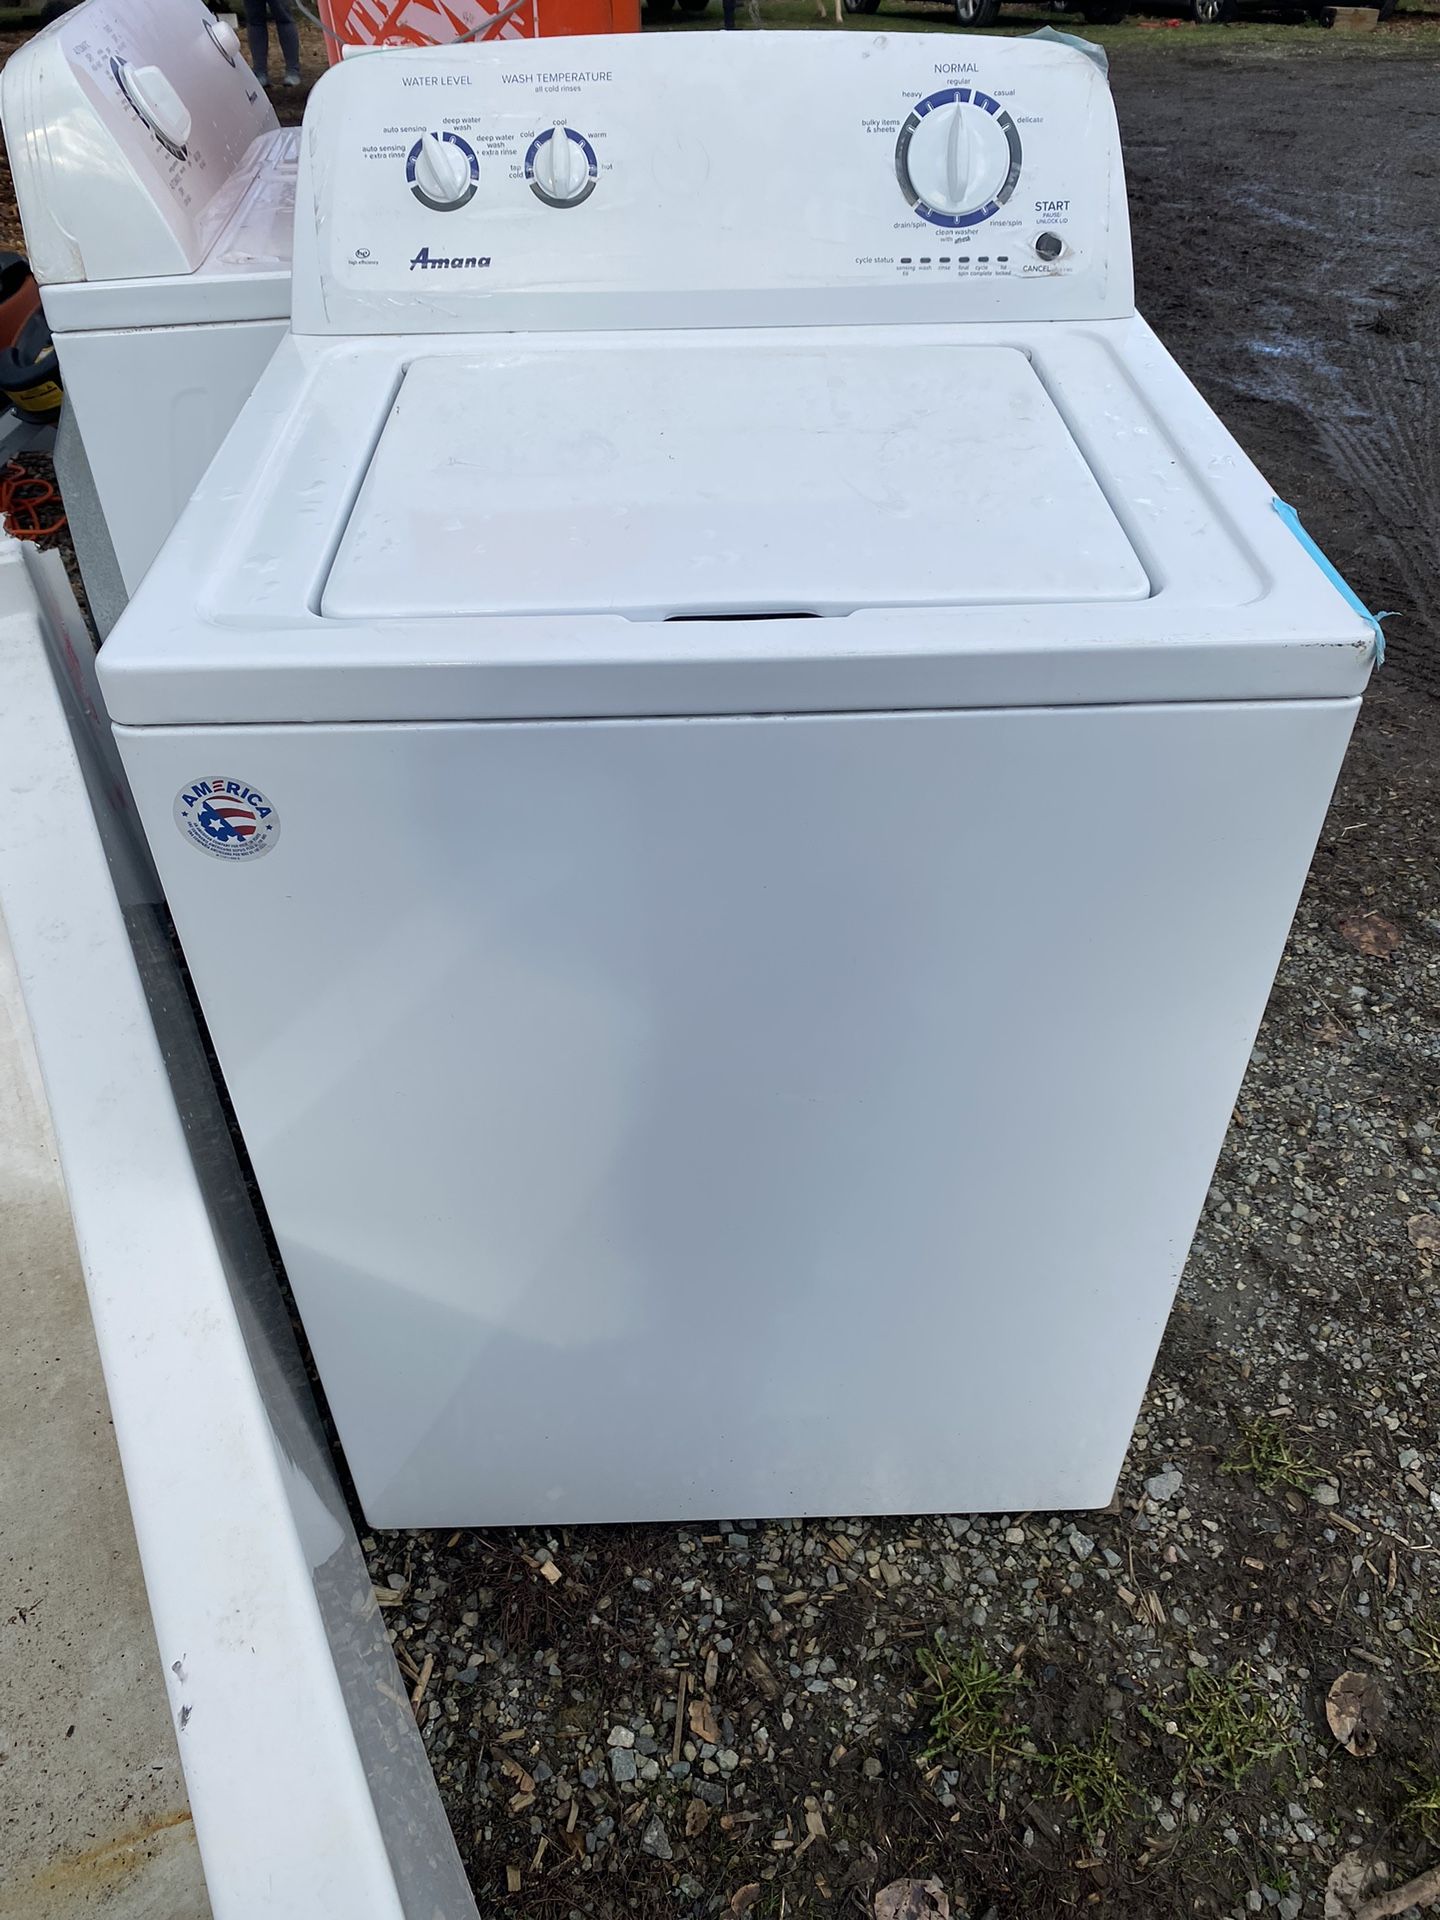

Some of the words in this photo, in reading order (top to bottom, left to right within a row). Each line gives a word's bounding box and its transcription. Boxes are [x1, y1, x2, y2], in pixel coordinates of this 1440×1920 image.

[934, 63, 979, 74] NORMAL
[401, 76, 439, 87] WATER
[441, 75, 472, 86] LEVEL
[501, 73, 533, 84] WASH
[537, 71, 612, 83] TEMPERATURE
[946, 78, 971, 86] regular
[544, 85, 559, 93] cold
[561, 85, 581, 93] rinses
[993, 88, 1016, 97] casual
[902, 90, 923, 98] heavy
[442, 117, 461, 125] deep
[552, 118, 568, 126] cool
[862, 119, 881, 127] bulky
[881, 118, 900, 126] items
[1017, 116, 1045, 124] delicate
[400, 125, 427, 133] sensing
[873, 125, 896, 133] sheets
[509, 171, 524, 179] cold
[1035, 200, 1070, 212] START
[893, 221, 927, 229] drain/spin
[409, 247, 491, 271] Amana
[855, 256, 872, 264] cycle
[874, 256, 894, 264] status
[1022, 264, 1051, 273] CANCEL
[181, 779, 272, 819] AMERICA
